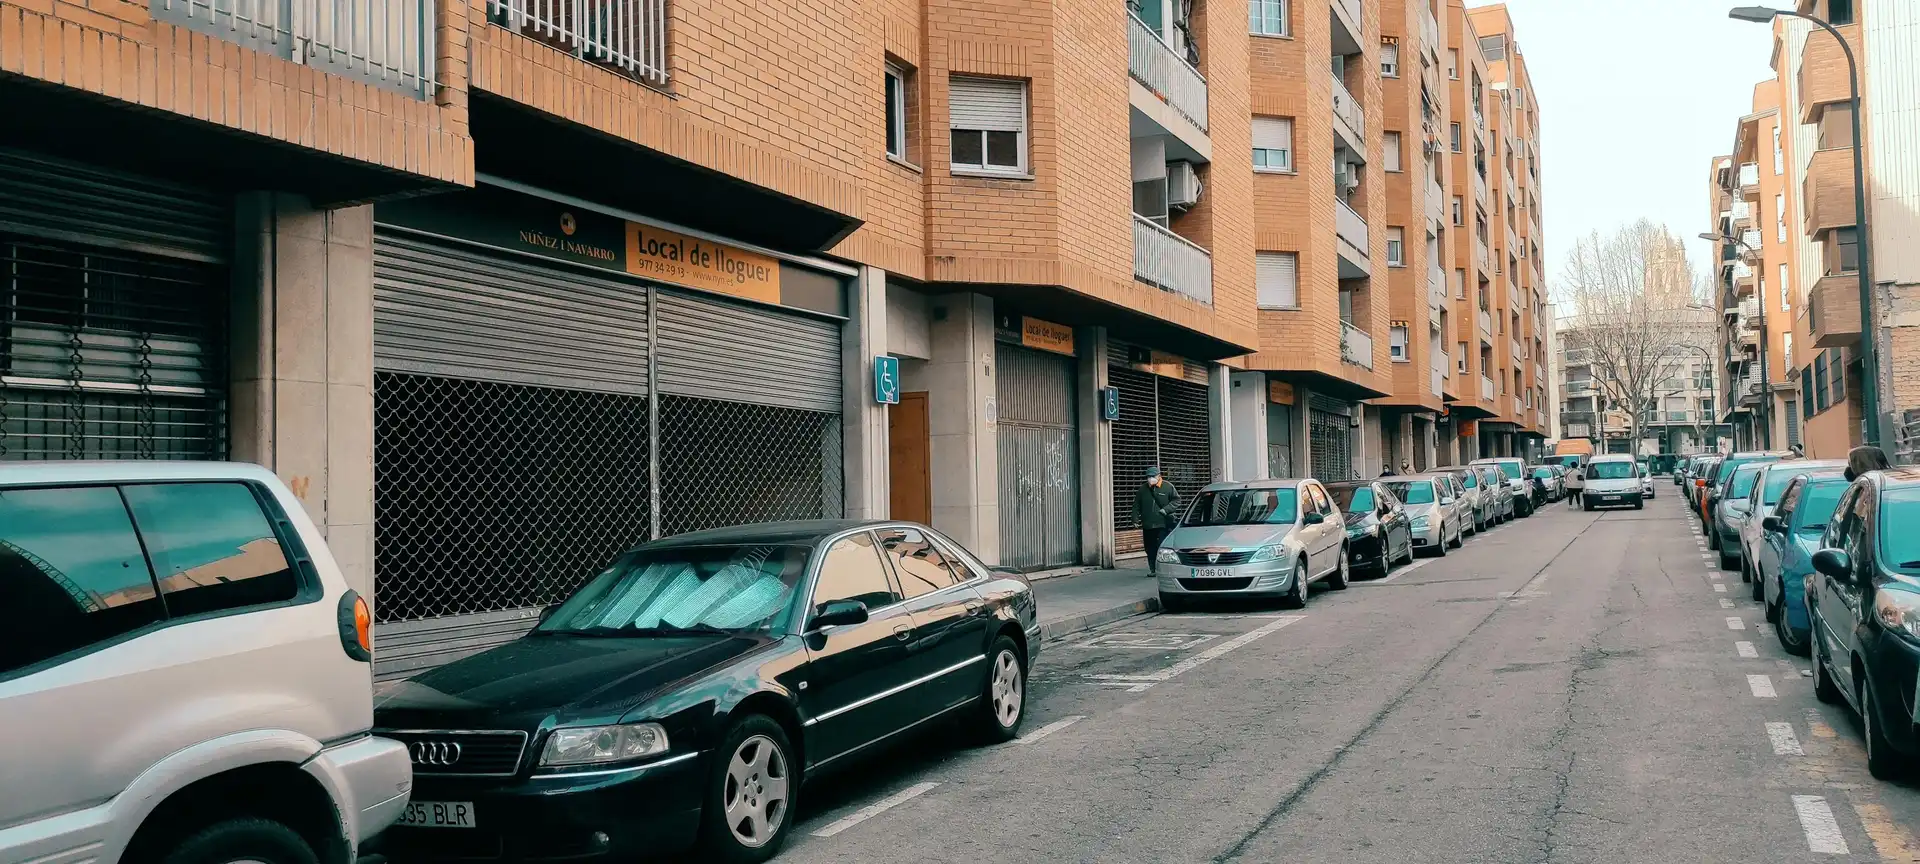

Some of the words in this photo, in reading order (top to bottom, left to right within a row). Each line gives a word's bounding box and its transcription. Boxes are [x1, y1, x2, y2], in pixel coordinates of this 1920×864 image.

[520, 229, 558, 249] NÚÑEZ
[567, 240, 615, 261] NAVARRO
[638, 230, 684, 262] Local
[689, 243, 710, 269] de
[715, 248, 771, 284] lloguer
[638, 258, 654, 271] 977
[655, 261, 665, 274] 34
[666, 264, 676, 276] 29
[677, 266, 685, 278] 13
[1195, 568, 1215, 577] 7096
[1217, 568, 1233, 577] GVL
[433, 803, 468, 825] BLR
